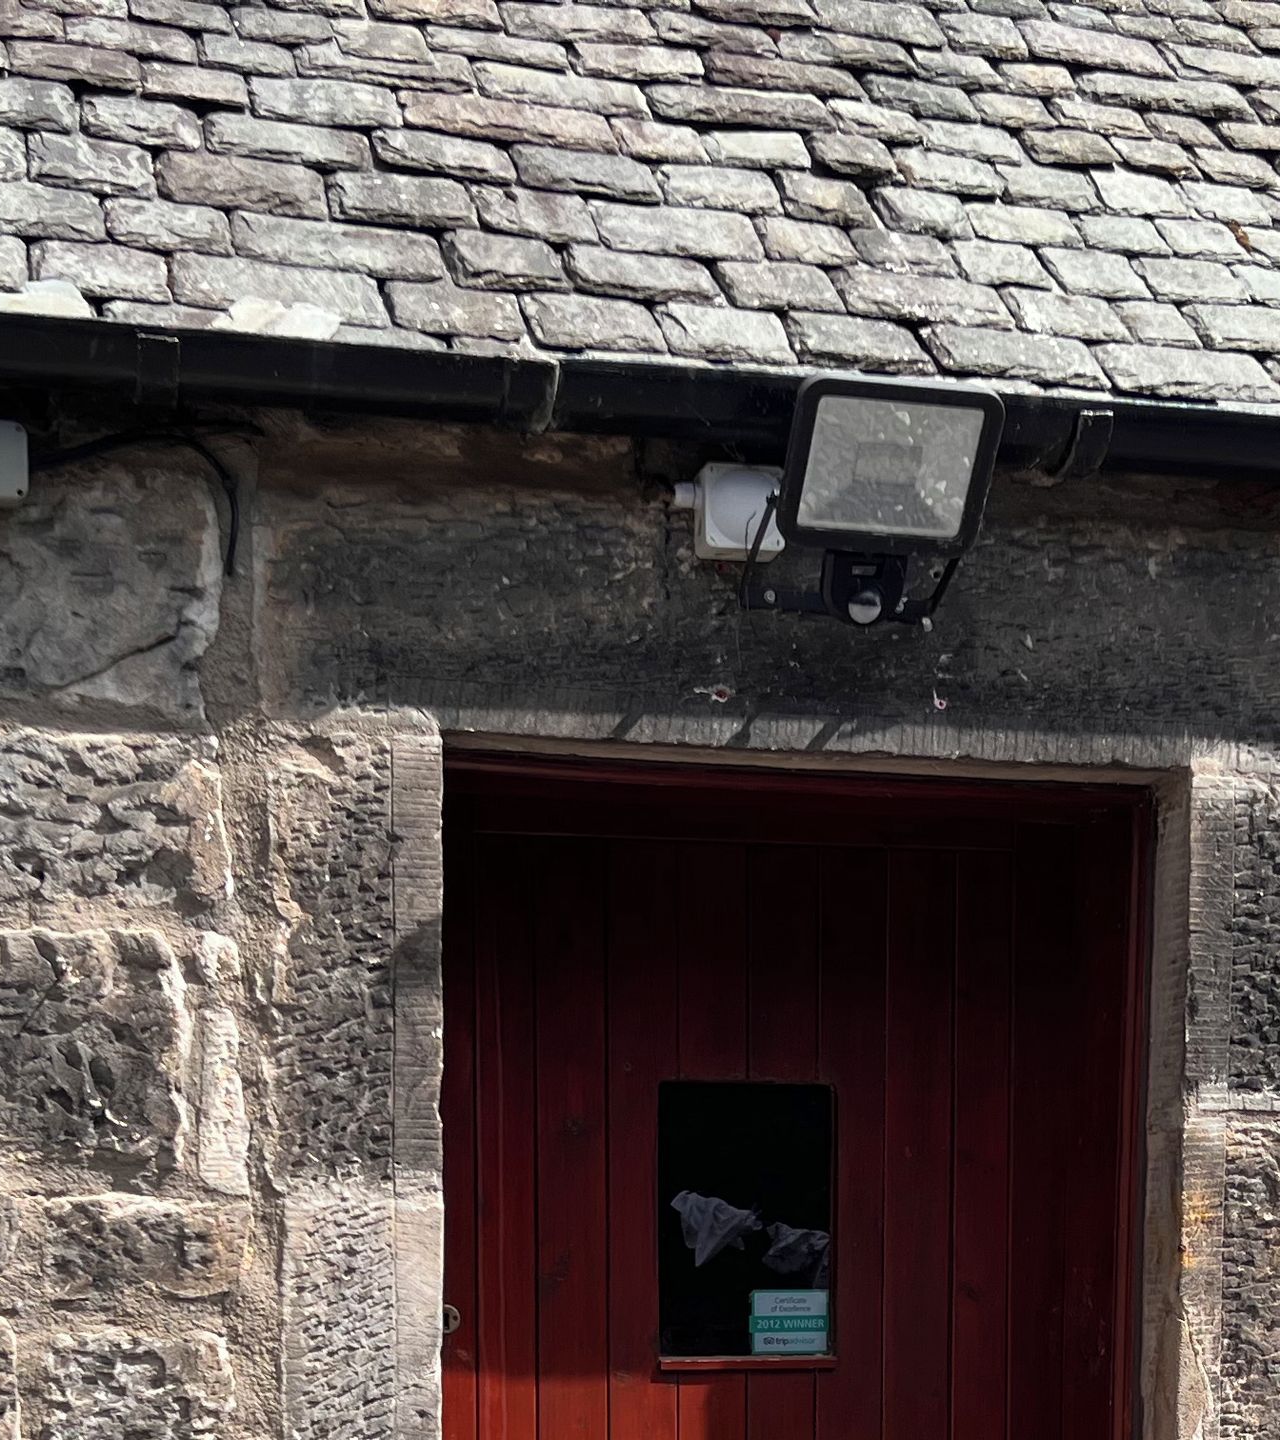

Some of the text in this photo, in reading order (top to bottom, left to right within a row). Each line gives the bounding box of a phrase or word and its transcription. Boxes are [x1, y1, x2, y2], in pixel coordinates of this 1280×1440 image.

[756, 1319, 825, 1329] 2012 WINNER
[775, 1337, 816, 1346] tripadvisor
